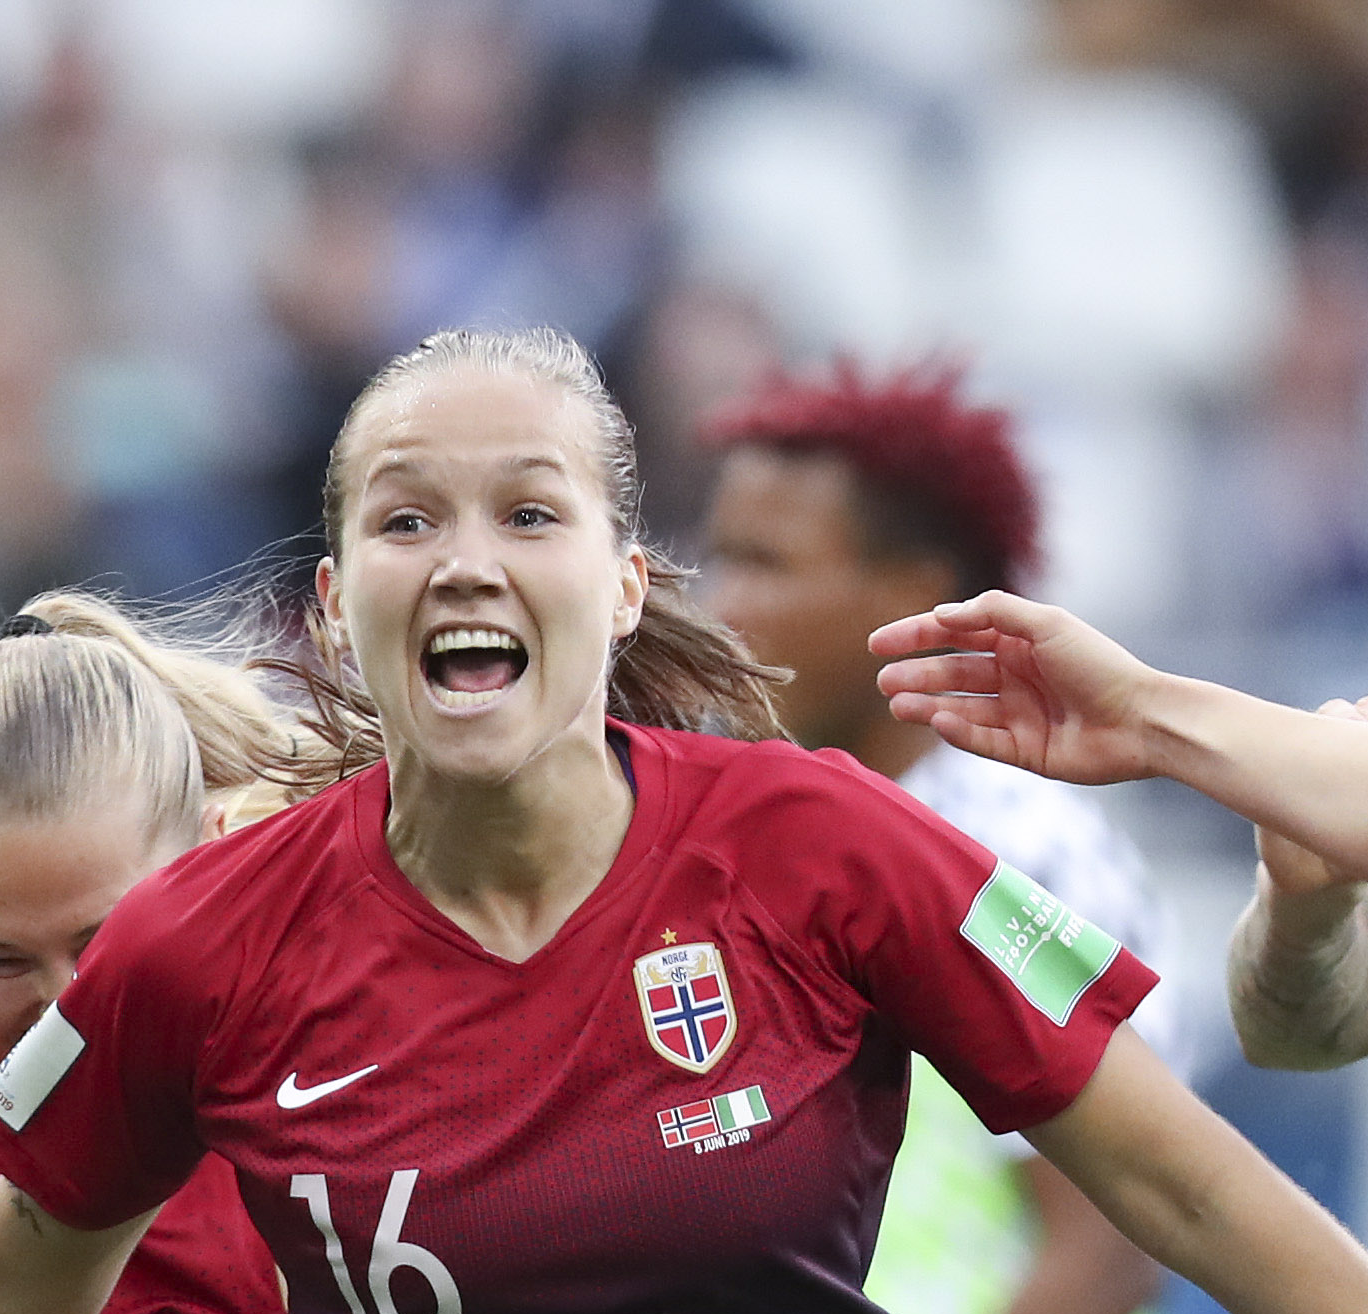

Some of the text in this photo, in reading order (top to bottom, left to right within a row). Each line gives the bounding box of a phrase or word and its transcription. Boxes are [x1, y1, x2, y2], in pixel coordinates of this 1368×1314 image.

[661, 950, 688, 966] NORGE
[694, 1128, 750, 1154] 8 JUNI 2019
